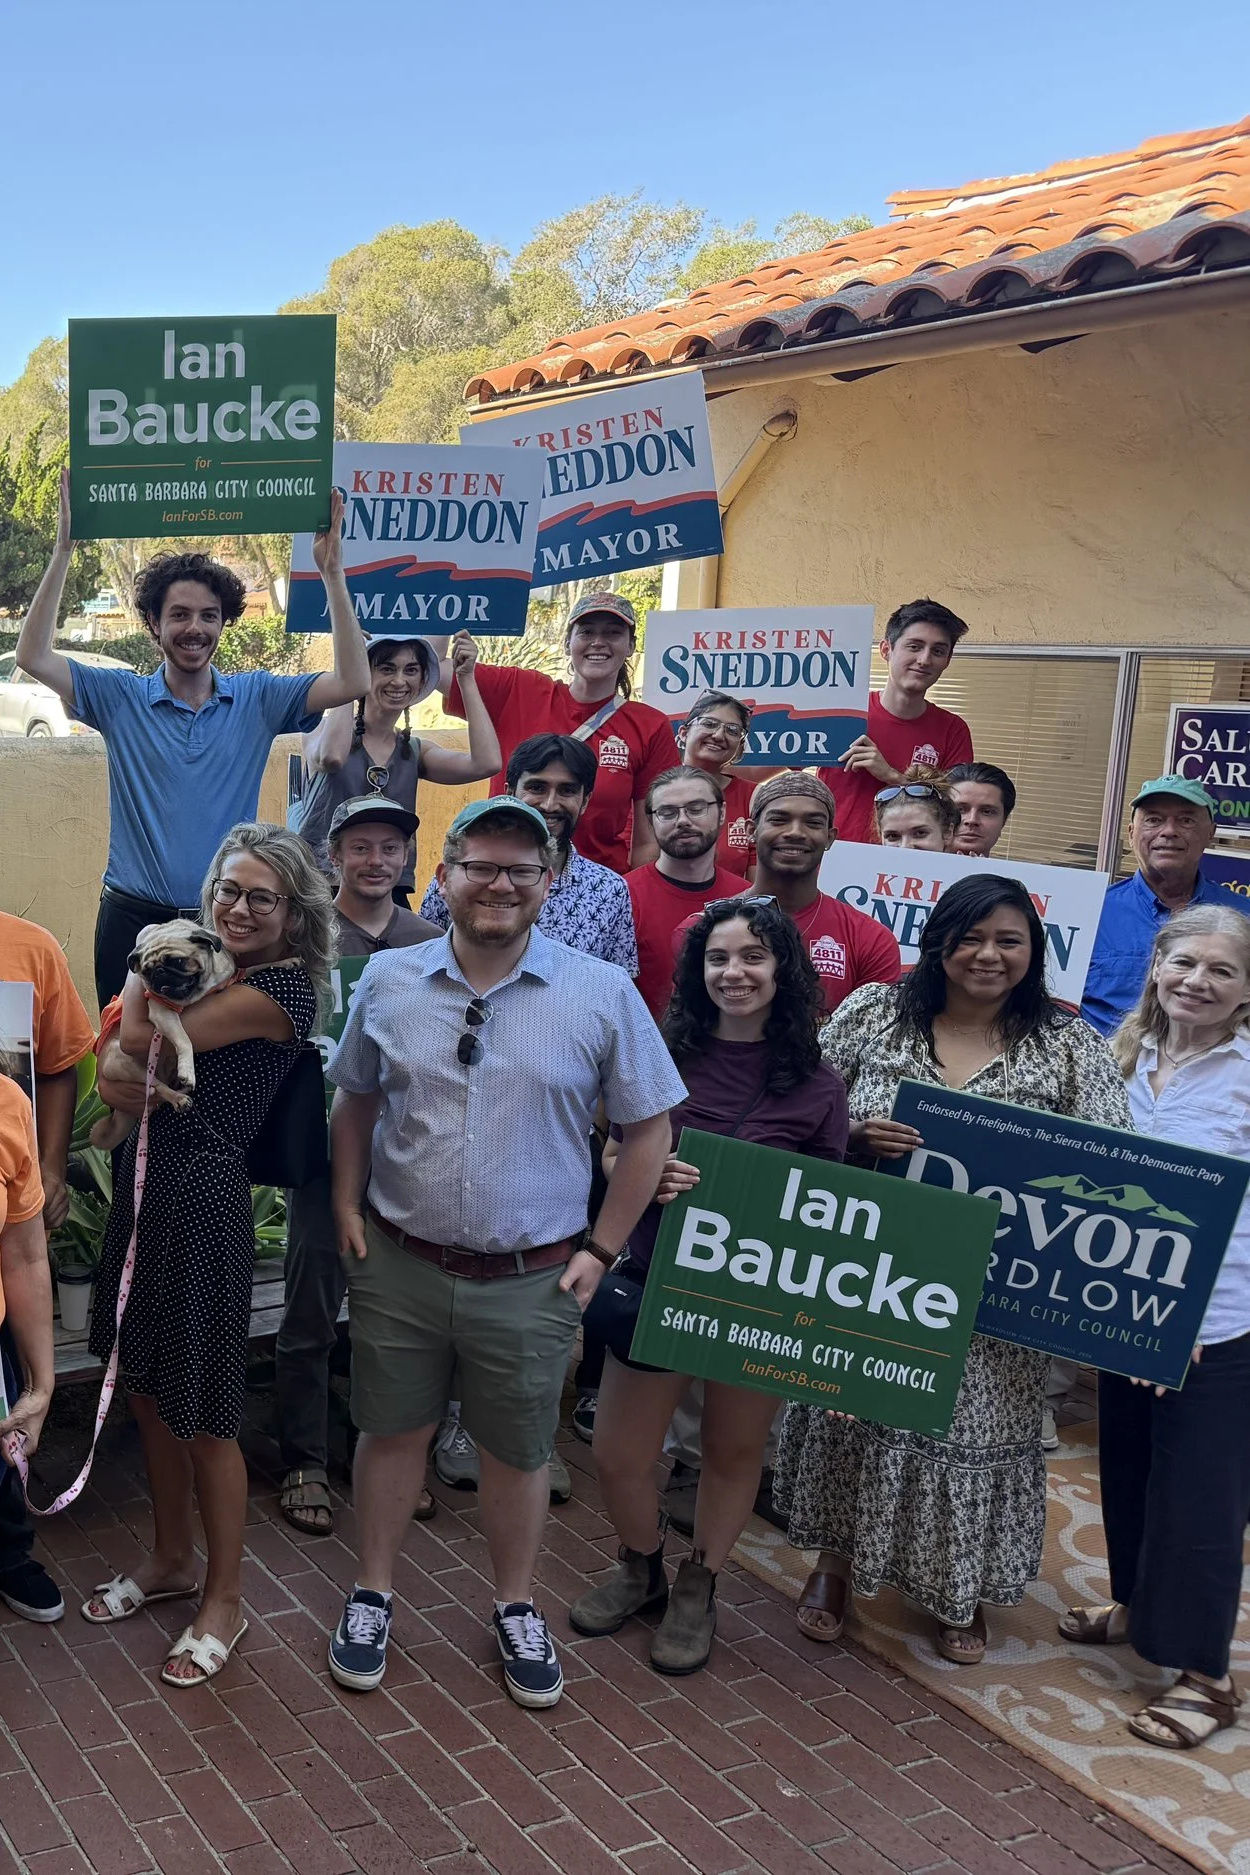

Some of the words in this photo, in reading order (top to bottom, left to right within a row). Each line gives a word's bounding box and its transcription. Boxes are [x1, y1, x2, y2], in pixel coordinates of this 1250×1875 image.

[164, 330, 245, 380] Ian
[88, 385, 320, 446] Baucke
[195, 456, 212, 471] for
[89, 482, 136, 502] SANTA
[146, 481, 207, 500] BARBARA
[215, 479, 248, 498] CITY
[256, 478, 316, 496] COUNCIL
[352, 470, 505, 496] KRISTEN
[162, 510, 243, 522] IanForSB.com
[540, 523, 682, 573] MAYOR
[354, 592, 490, 622] MAYOR
[692, 629, 833, 650] KRISTEN
[660, 646, 859, 694] SNEDDON
[916, 754, 936, 764] 4811
[814, 949, 841, 959] 4811
[917, 1100, 961, 1120] Endorsed
[962, 1111, 974, 1126] By
[976, 1114, 1032, 1139] Firefighters,
[1034, 1128, 1052, 1142] The
[1052, 1132, 1082, 1150] Sierra
[1083, 1140, 1108, 1157] Club,
[1110, 1147, 1119, 1157] &
[1120, 1149, 1139, 1163] The
[1140, 1154, 1196, 1177] Democratic
[1196, 1168, 1226, 1186] Party
[779, 1167, 881, 1241] Ian
[674, 1205, 959, 1329] Baucke
[793, 1311, 816, 1328] for
[1031, 1305, 1071, 1326] CITY
[1079, 1319, 1162, 1352] COUNCIL
[661, 1307, 718, 1339] SANTA
[728, 1322, 802, 1361] BARBARA
[812, 1343, 854, 1372] CITY
[862, 1356, 936, 1393] COUNCIL
[741, 1359, 841, 1395] IanForSB.com
